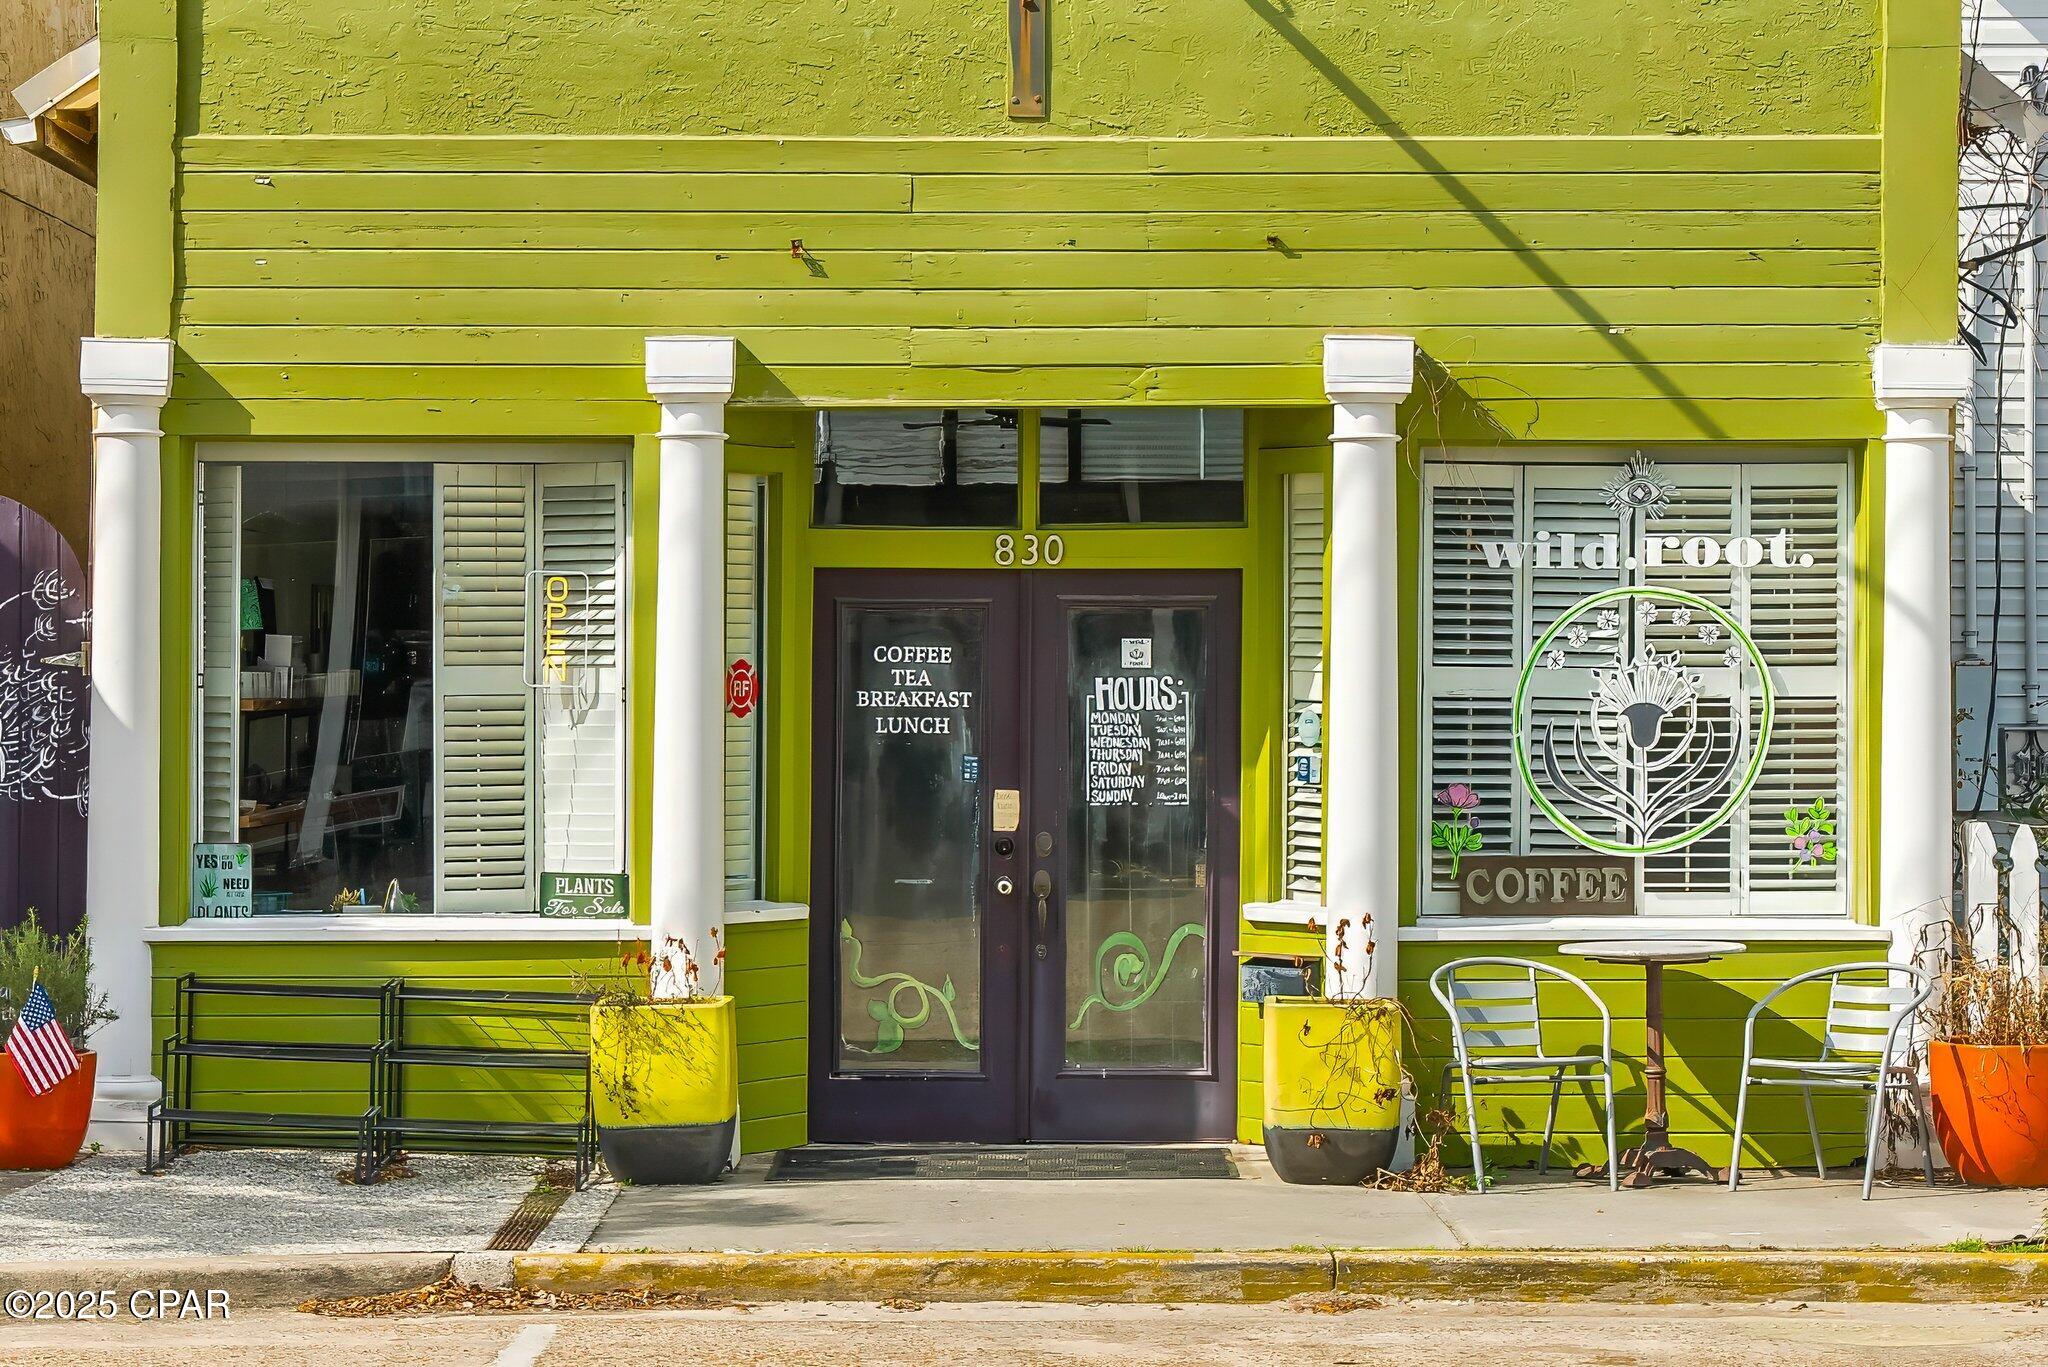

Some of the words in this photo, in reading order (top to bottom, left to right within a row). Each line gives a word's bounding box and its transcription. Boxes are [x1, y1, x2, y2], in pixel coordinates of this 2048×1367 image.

[994, 534, 1064, 566] 830
[543, 576, 569, 682] OPEN
[873, 645, 953, 664] COFFEE
[891, 669, 932, 686] TEA
[856, 690, 973, 708] BREAKFAST
[875, 716, 951, 734] LUNCH
[1090, 711, 1140, 726] MONDAY
[1090, 724, 1142, 737] TUESDAY
[1090, 736, 1151, 751] WEDNESDAY
[1090, 748, 1143, 766] THURSDAY
[1090, 761, 1132, 776] FRIDAY
[1090, 775, 1145, 789] SATURDAY
[1090, 789, 1134, 803] SUNDAY
[196, 854, 218, 869] YES
[223, 878, 250, 890] NEED
[555, 877, 615, 895] PLANTS
[1465, 867, 1628, 905] COFFEE
[543, 898, 579, 917] For
[583, 896, 625, 915] Sale
